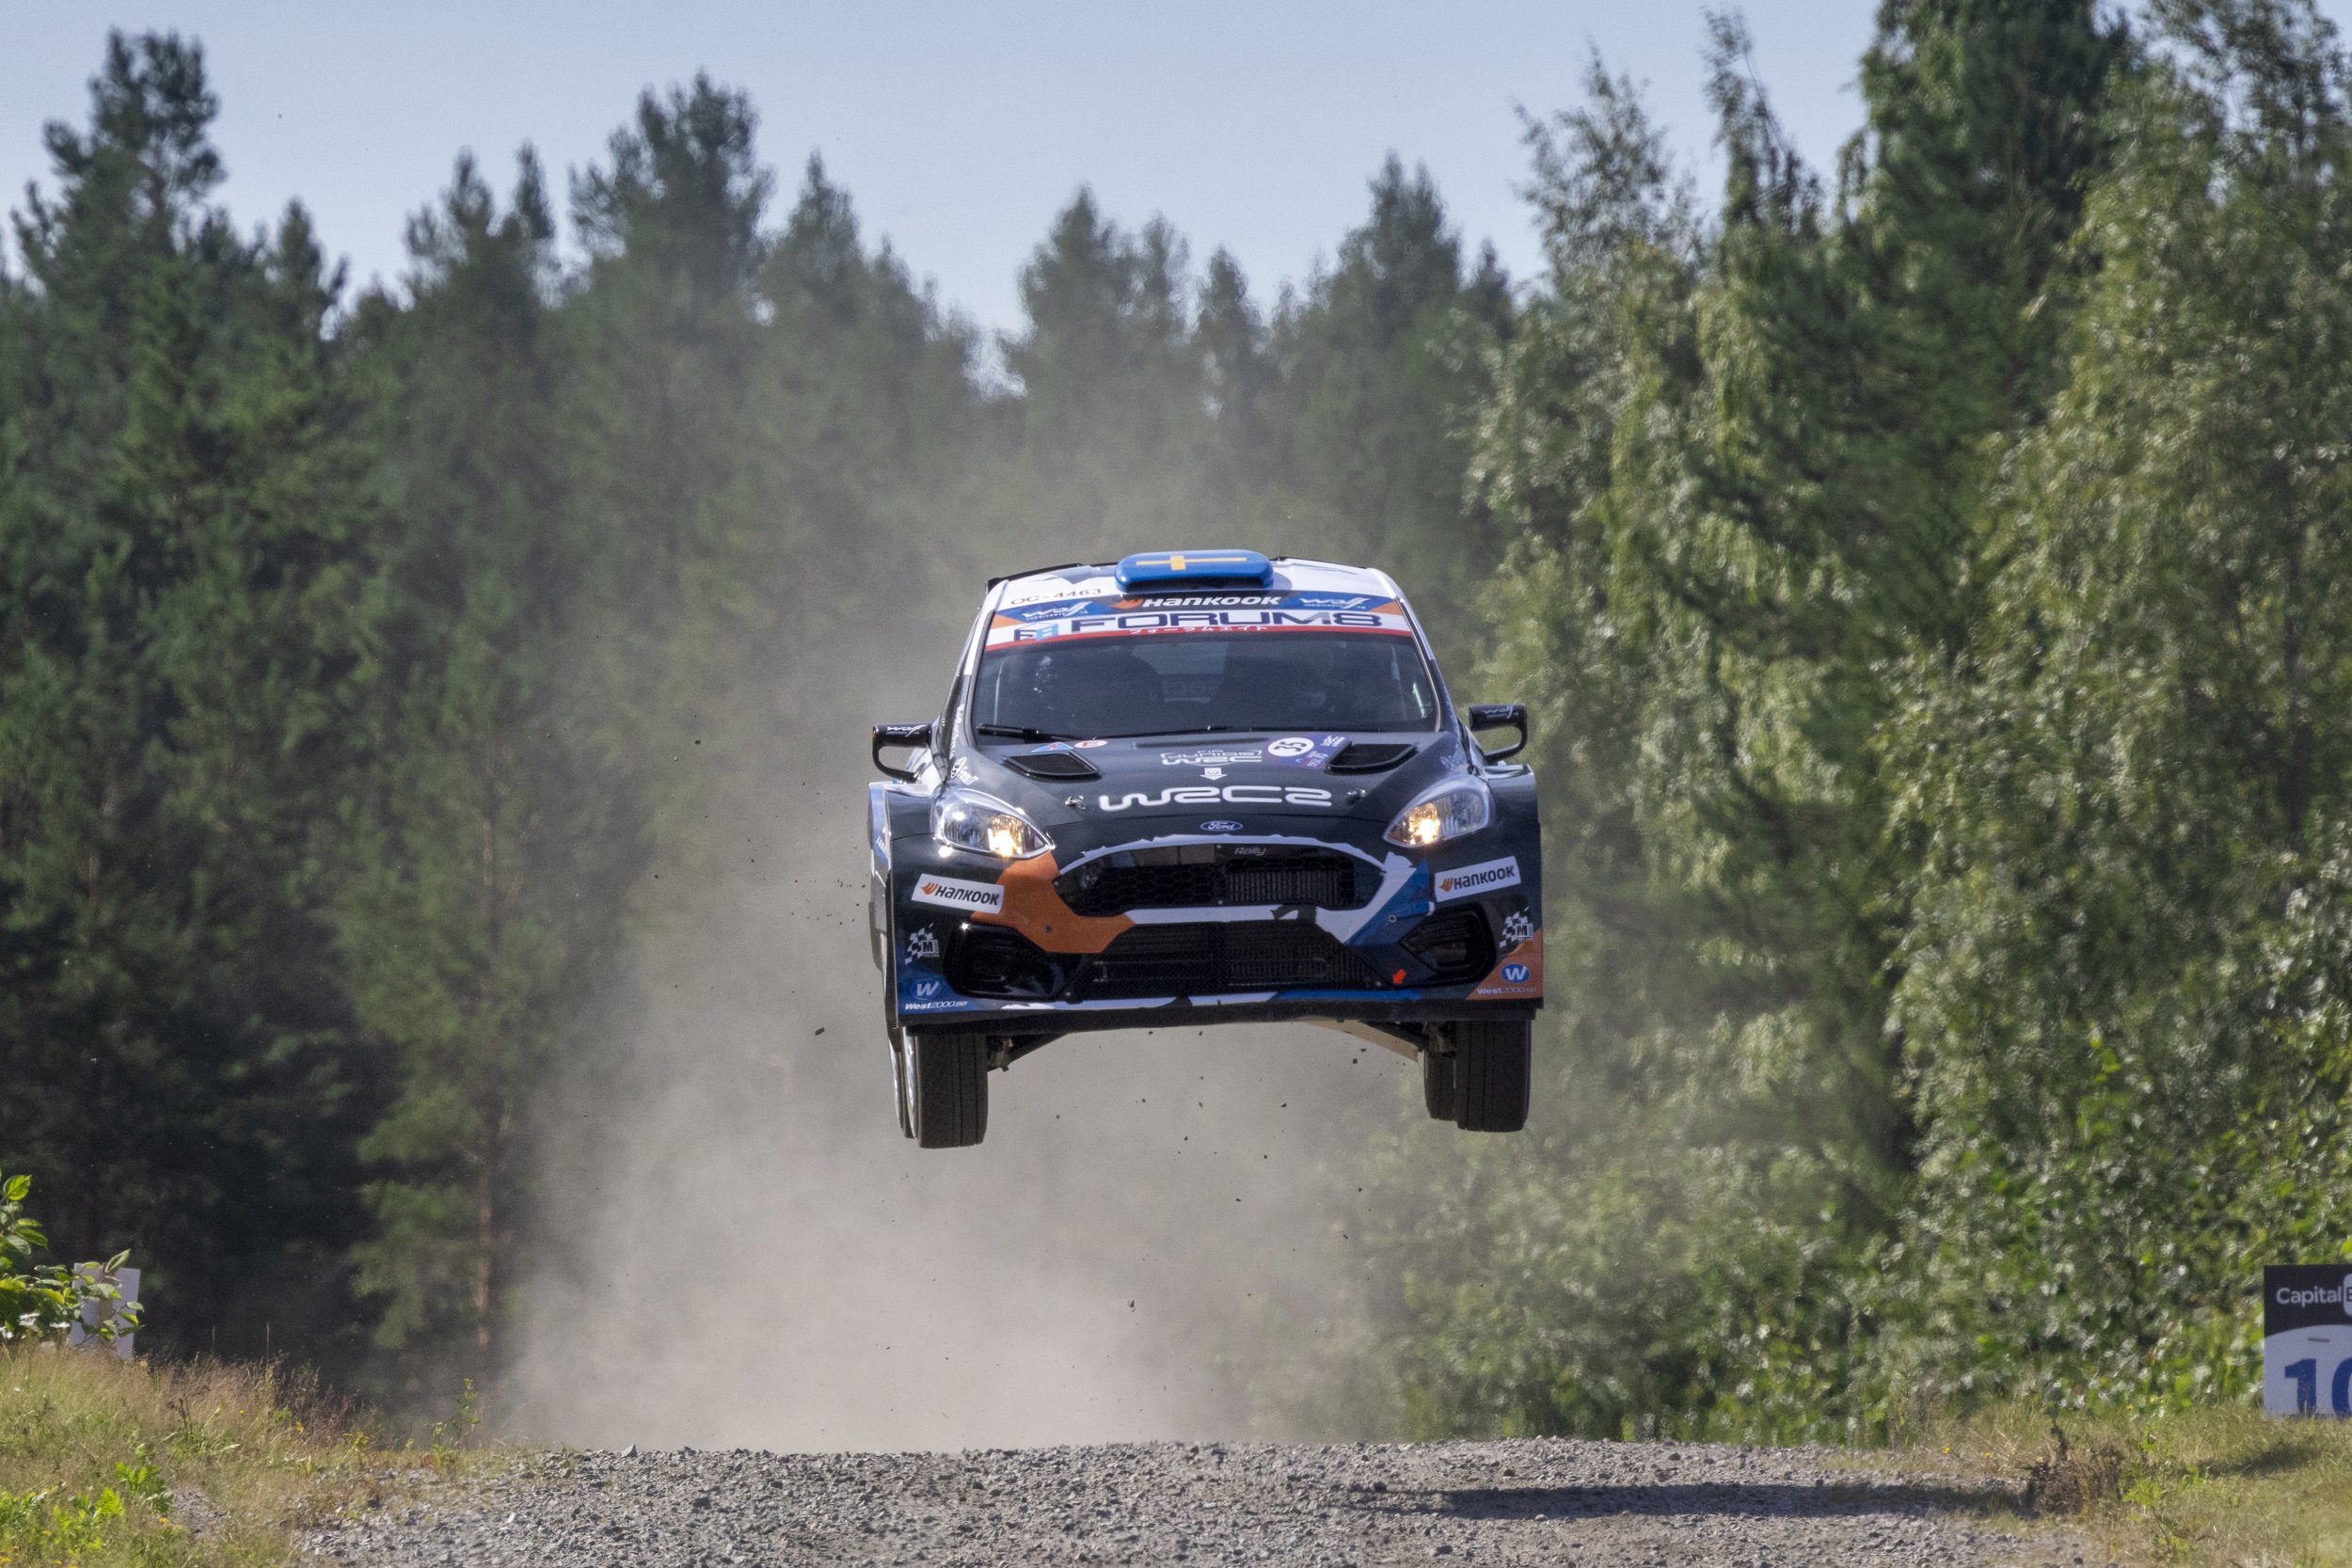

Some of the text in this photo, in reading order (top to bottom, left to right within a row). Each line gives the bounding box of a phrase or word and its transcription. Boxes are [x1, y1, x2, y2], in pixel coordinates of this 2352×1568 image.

[1072, 611, 1382, 633] FORUM8
[1099, 785, 1332, 811] WRC2
[1208, 821, 1235, 830] Ford
[2277, 1286, 2343, 1308] Capital
